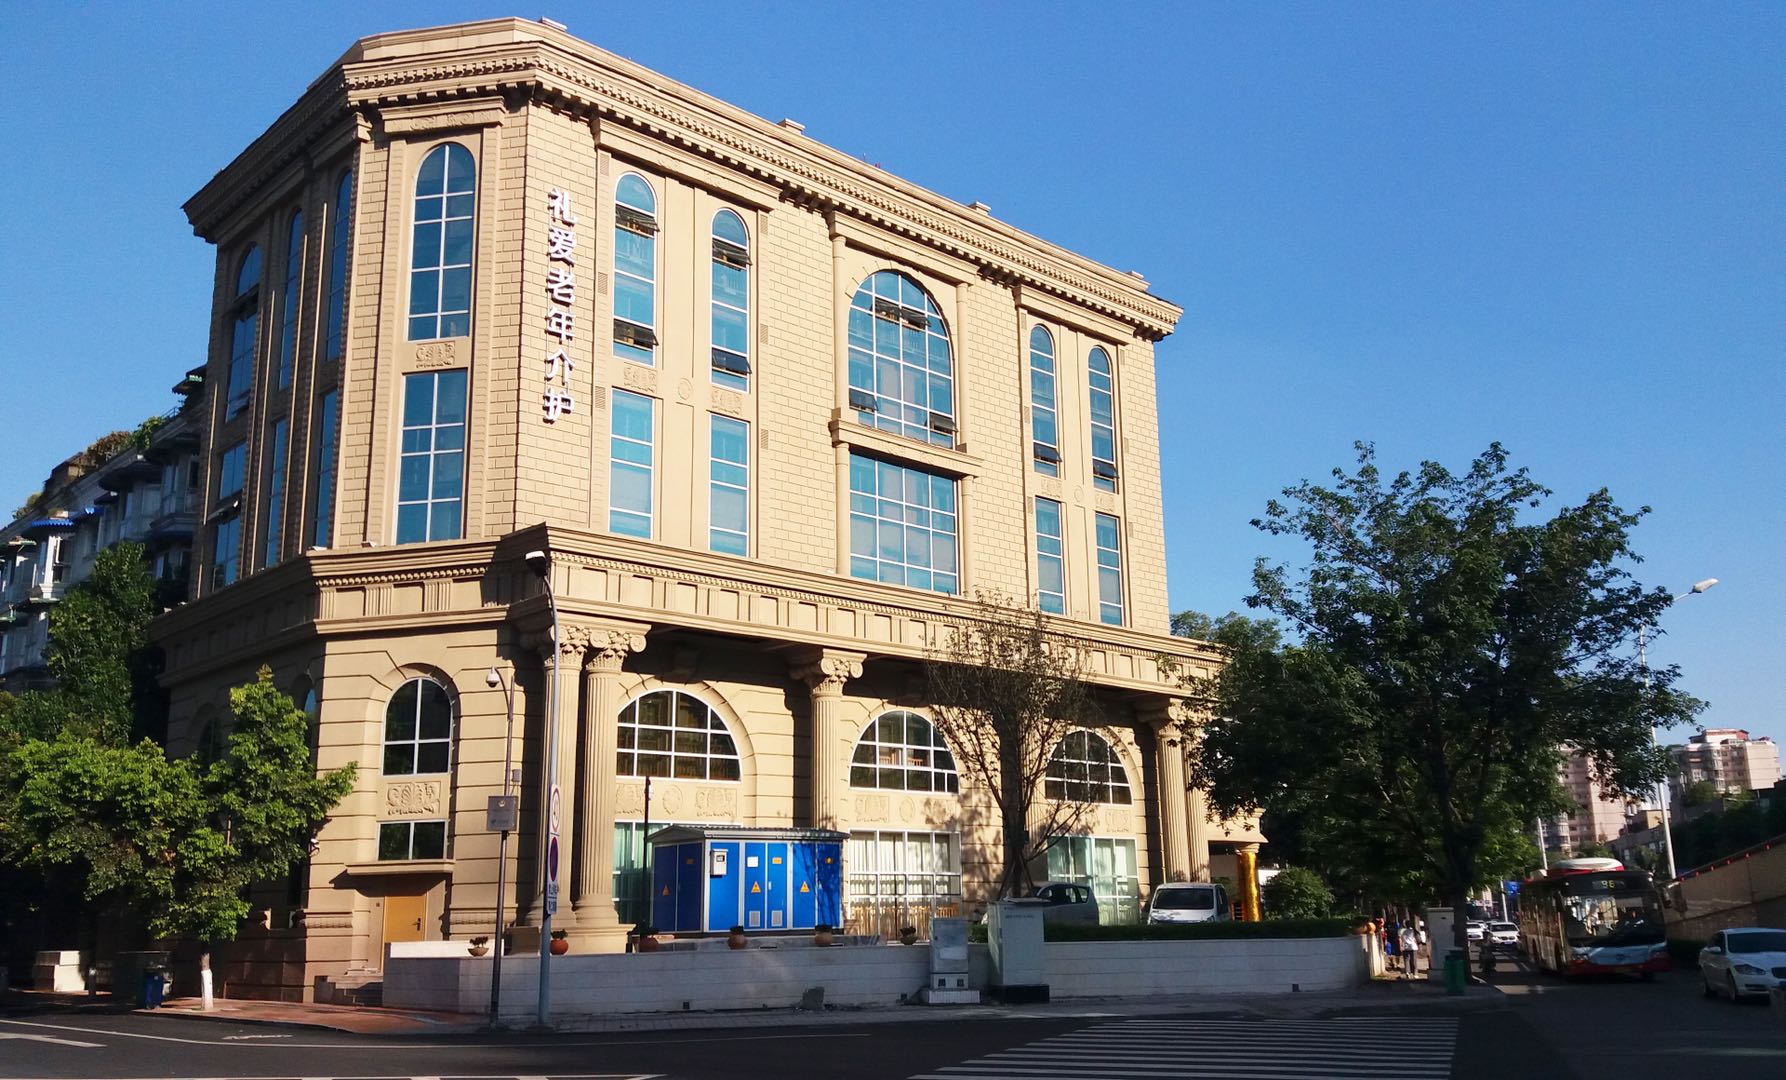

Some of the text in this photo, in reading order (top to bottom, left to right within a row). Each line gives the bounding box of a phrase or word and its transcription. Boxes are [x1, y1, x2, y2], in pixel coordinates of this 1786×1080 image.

[543, 188, 577, 423] 礼爱老年介护
